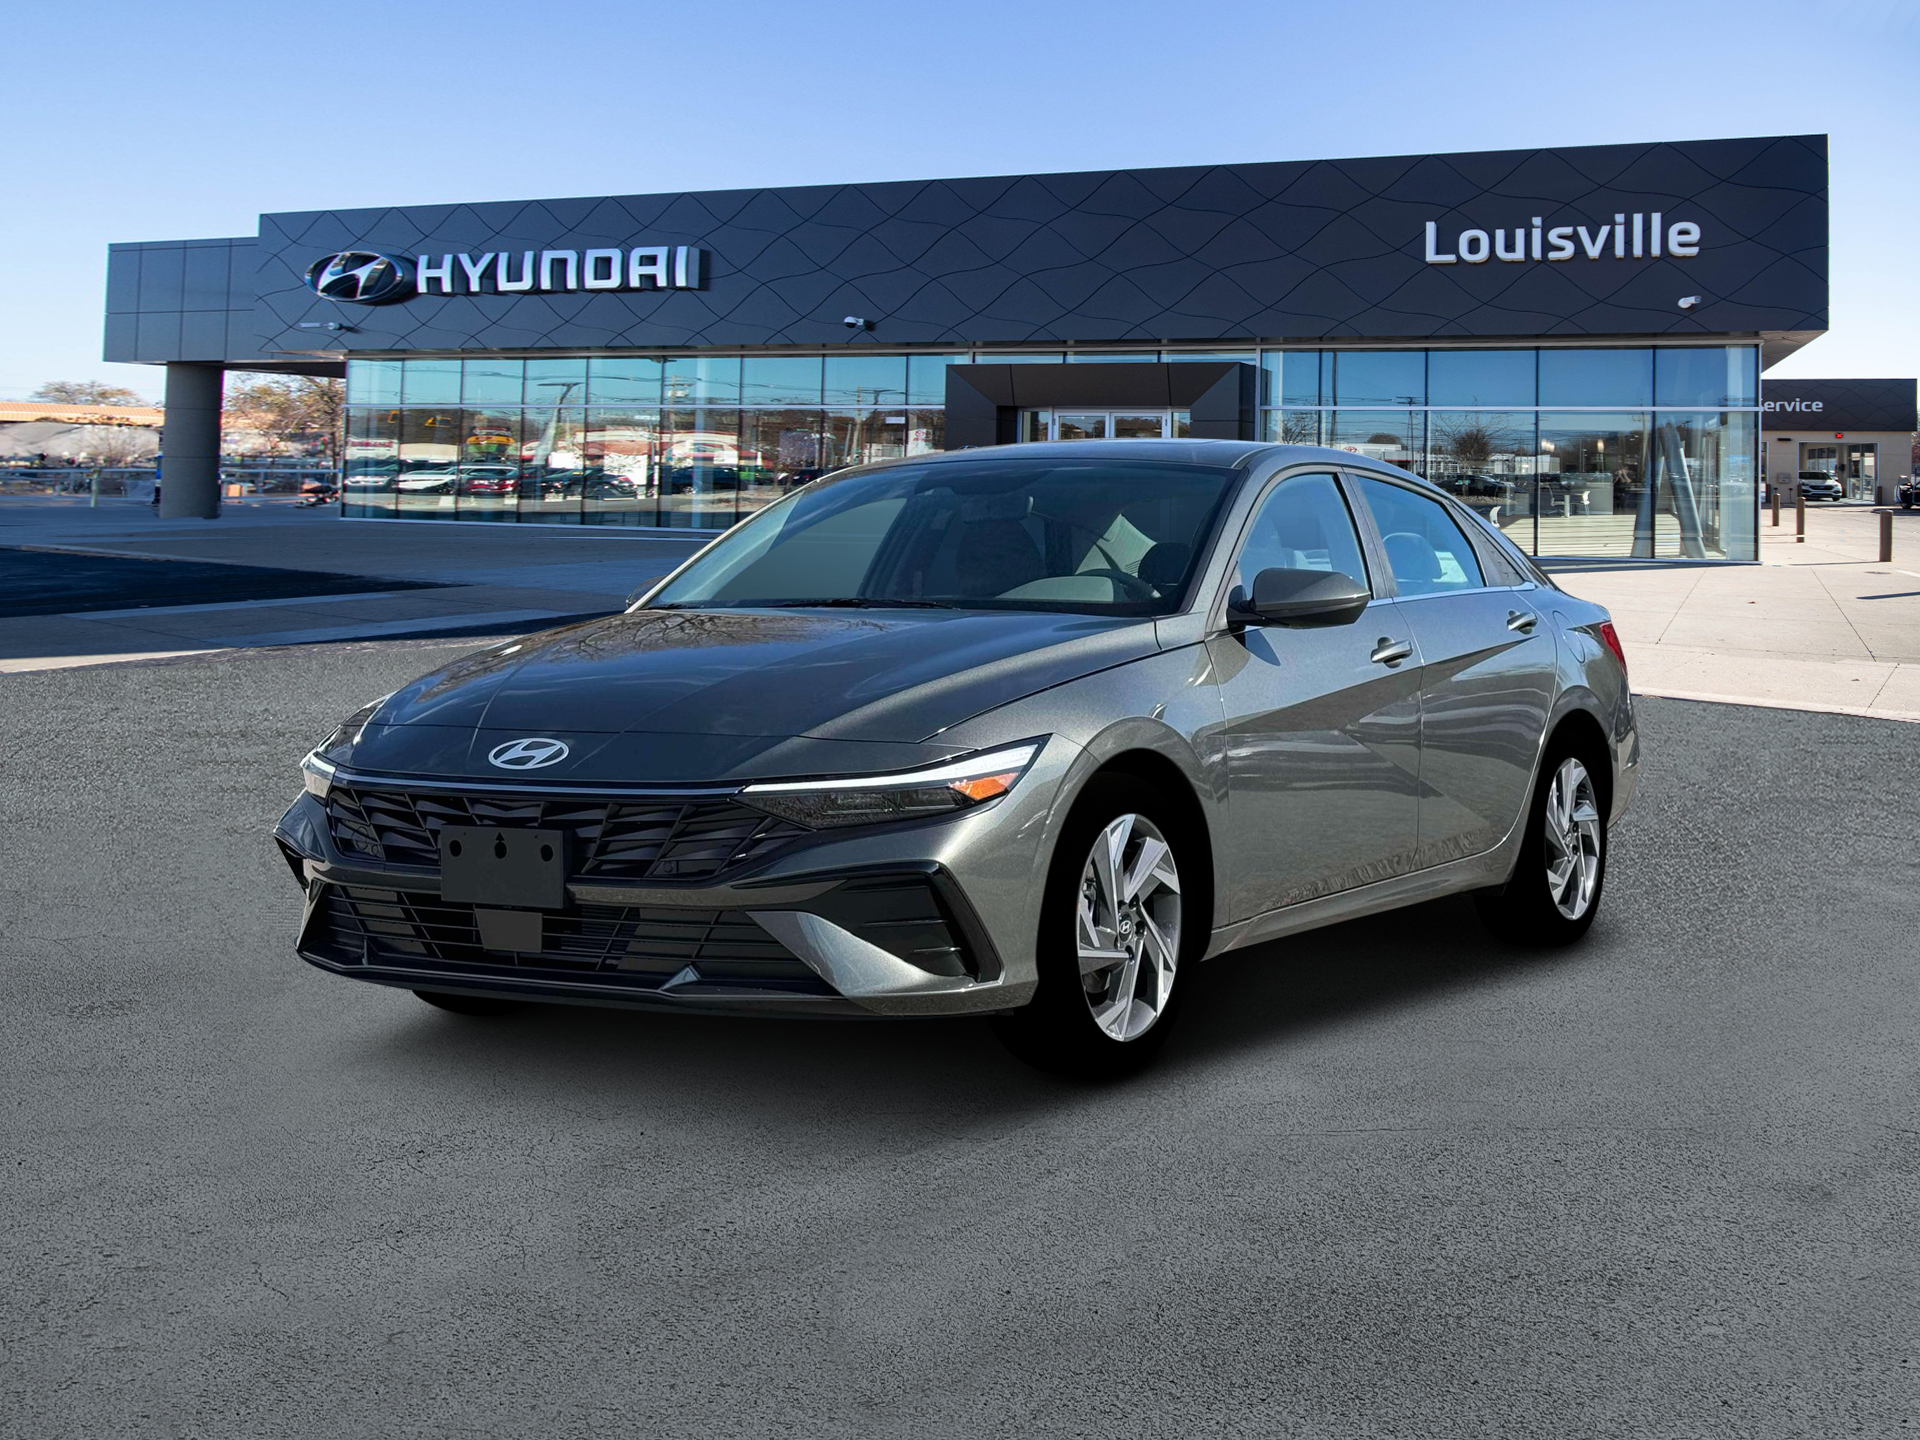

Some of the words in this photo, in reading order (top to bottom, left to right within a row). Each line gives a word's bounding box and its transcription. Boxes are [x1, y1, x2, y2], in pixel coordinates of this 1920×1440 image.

[1425, 212, 1701, 263] Louisville
[417, 245, 691, 293] HYUNDAI
[1761, 398, 1824, 412] ervice
